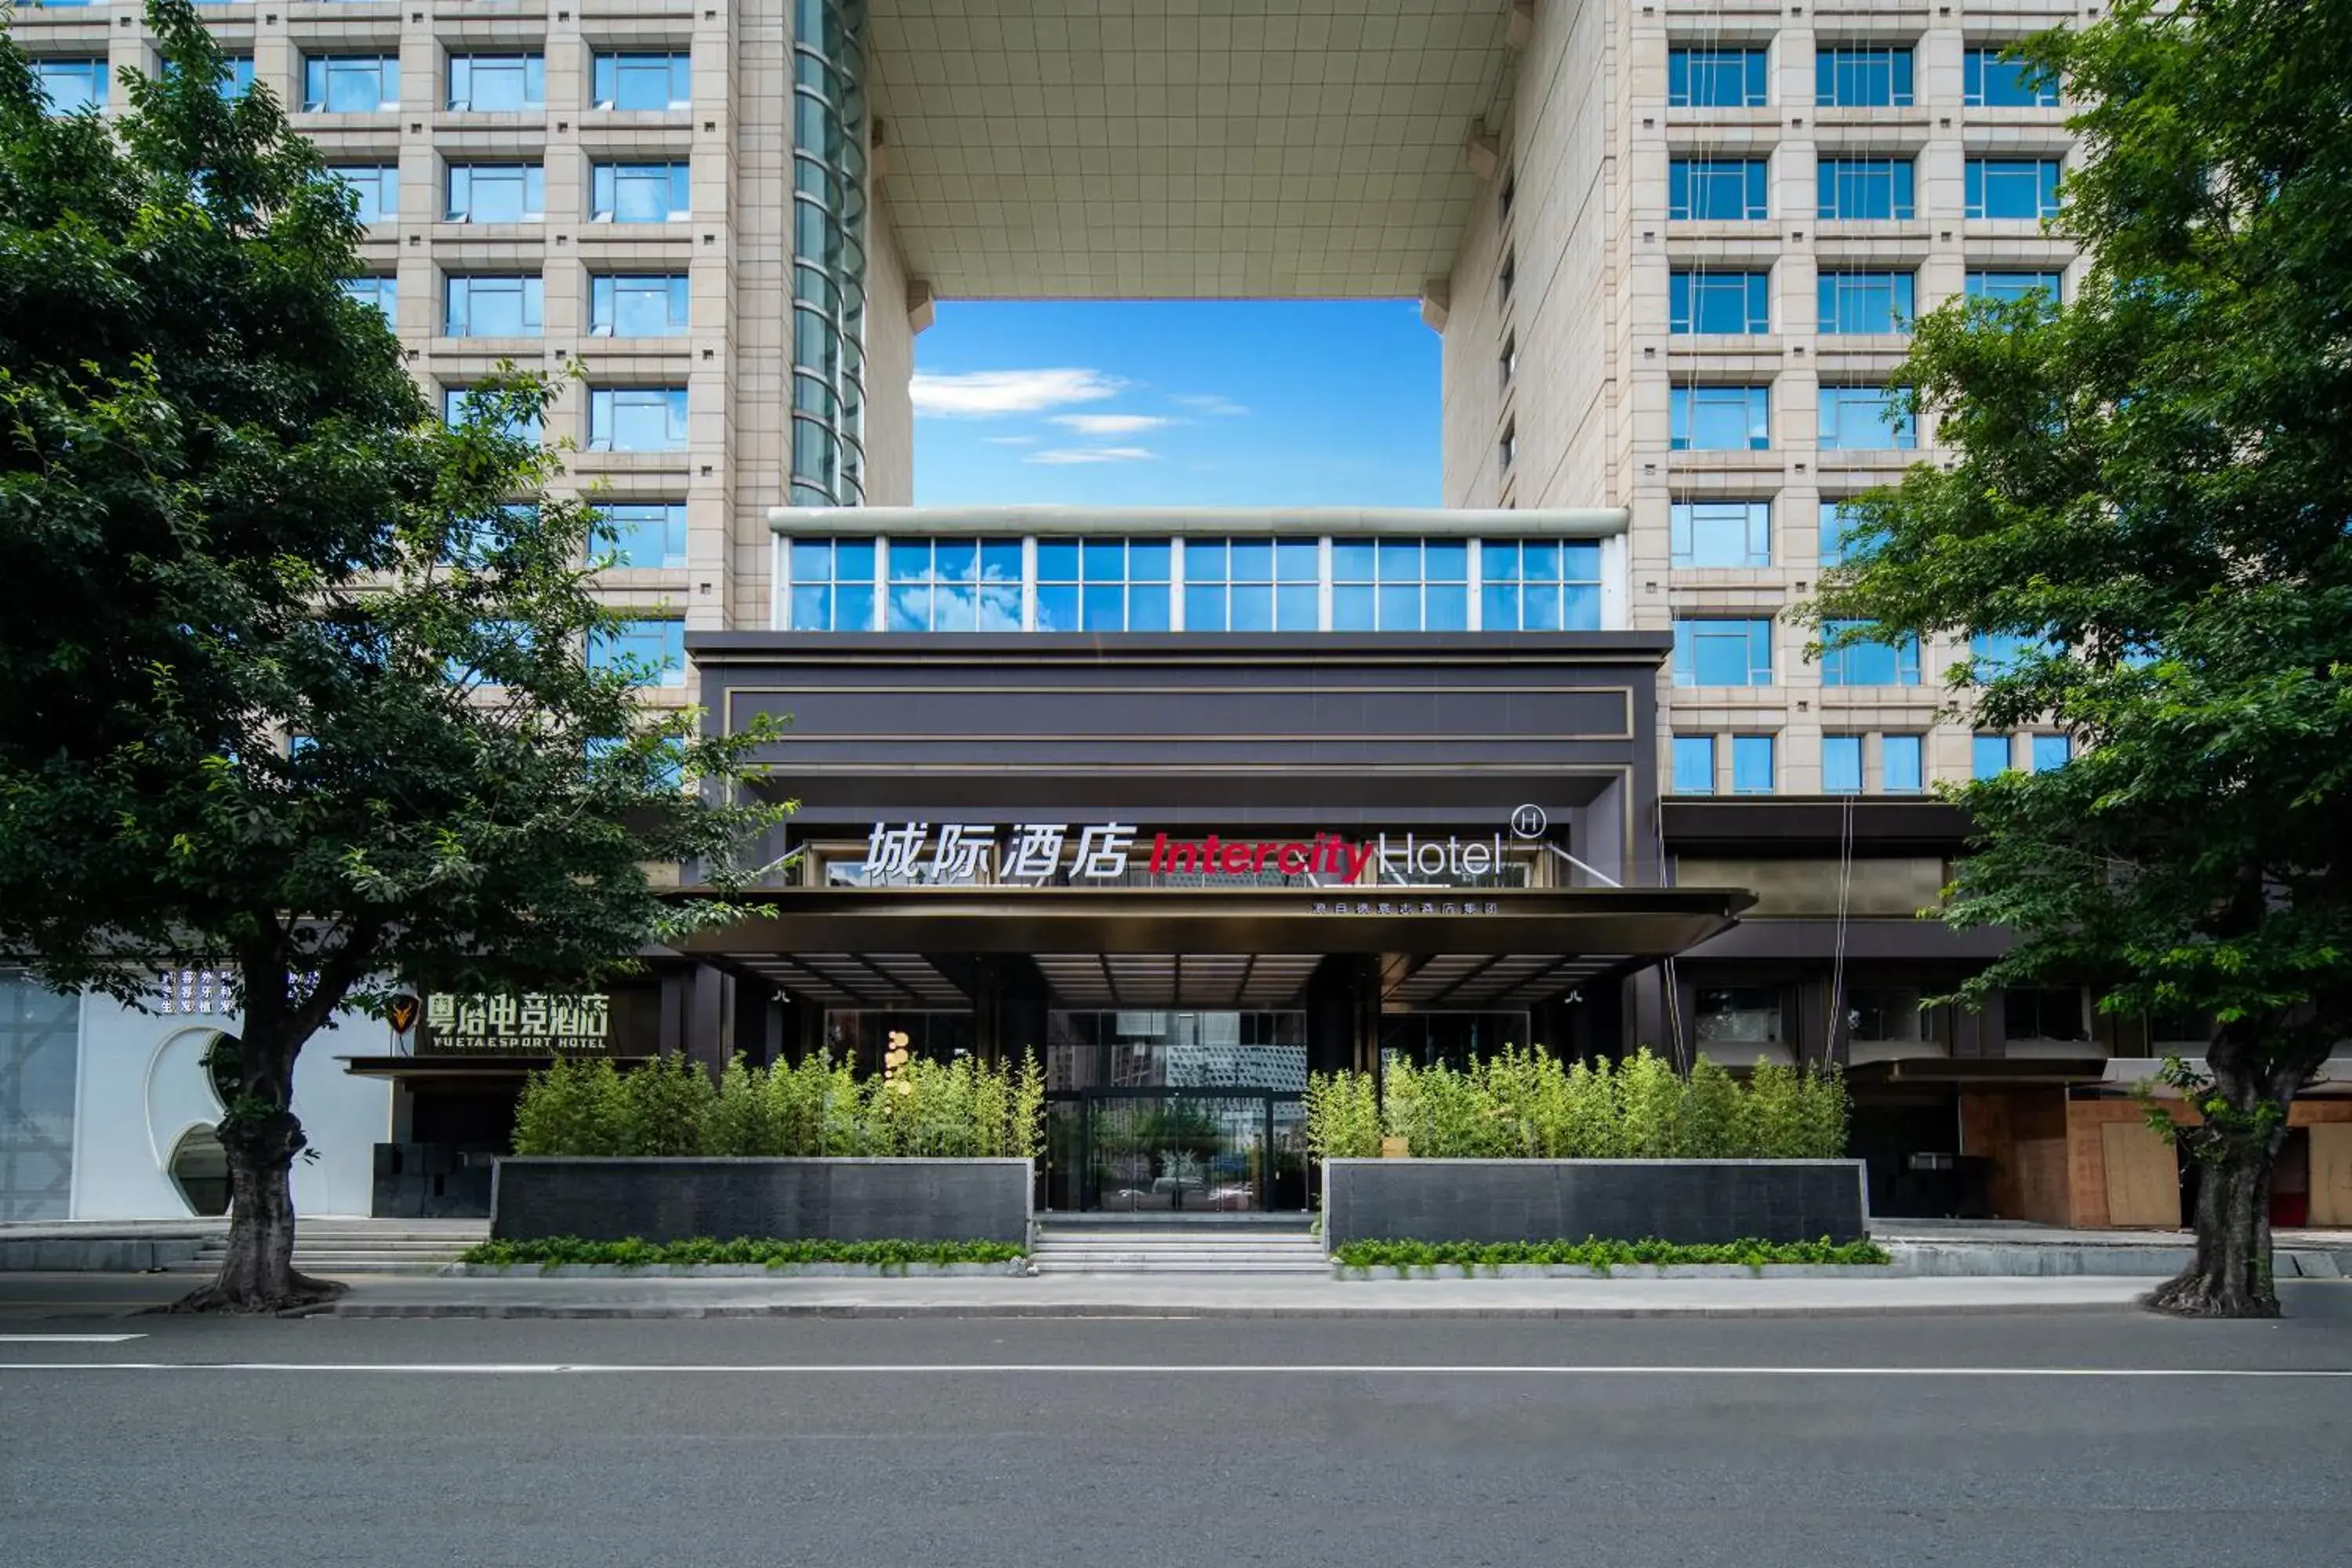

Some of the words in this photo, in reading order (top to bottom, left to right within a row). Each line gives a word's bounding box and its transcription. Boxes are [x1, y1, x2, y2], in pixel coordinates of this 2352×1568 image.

[862, 822, 1137, 879] 城际酒店
[426, 992, 610, 1036] 粤塔电竞酒店
[557, 1036, 607, 1047] HOTEL
